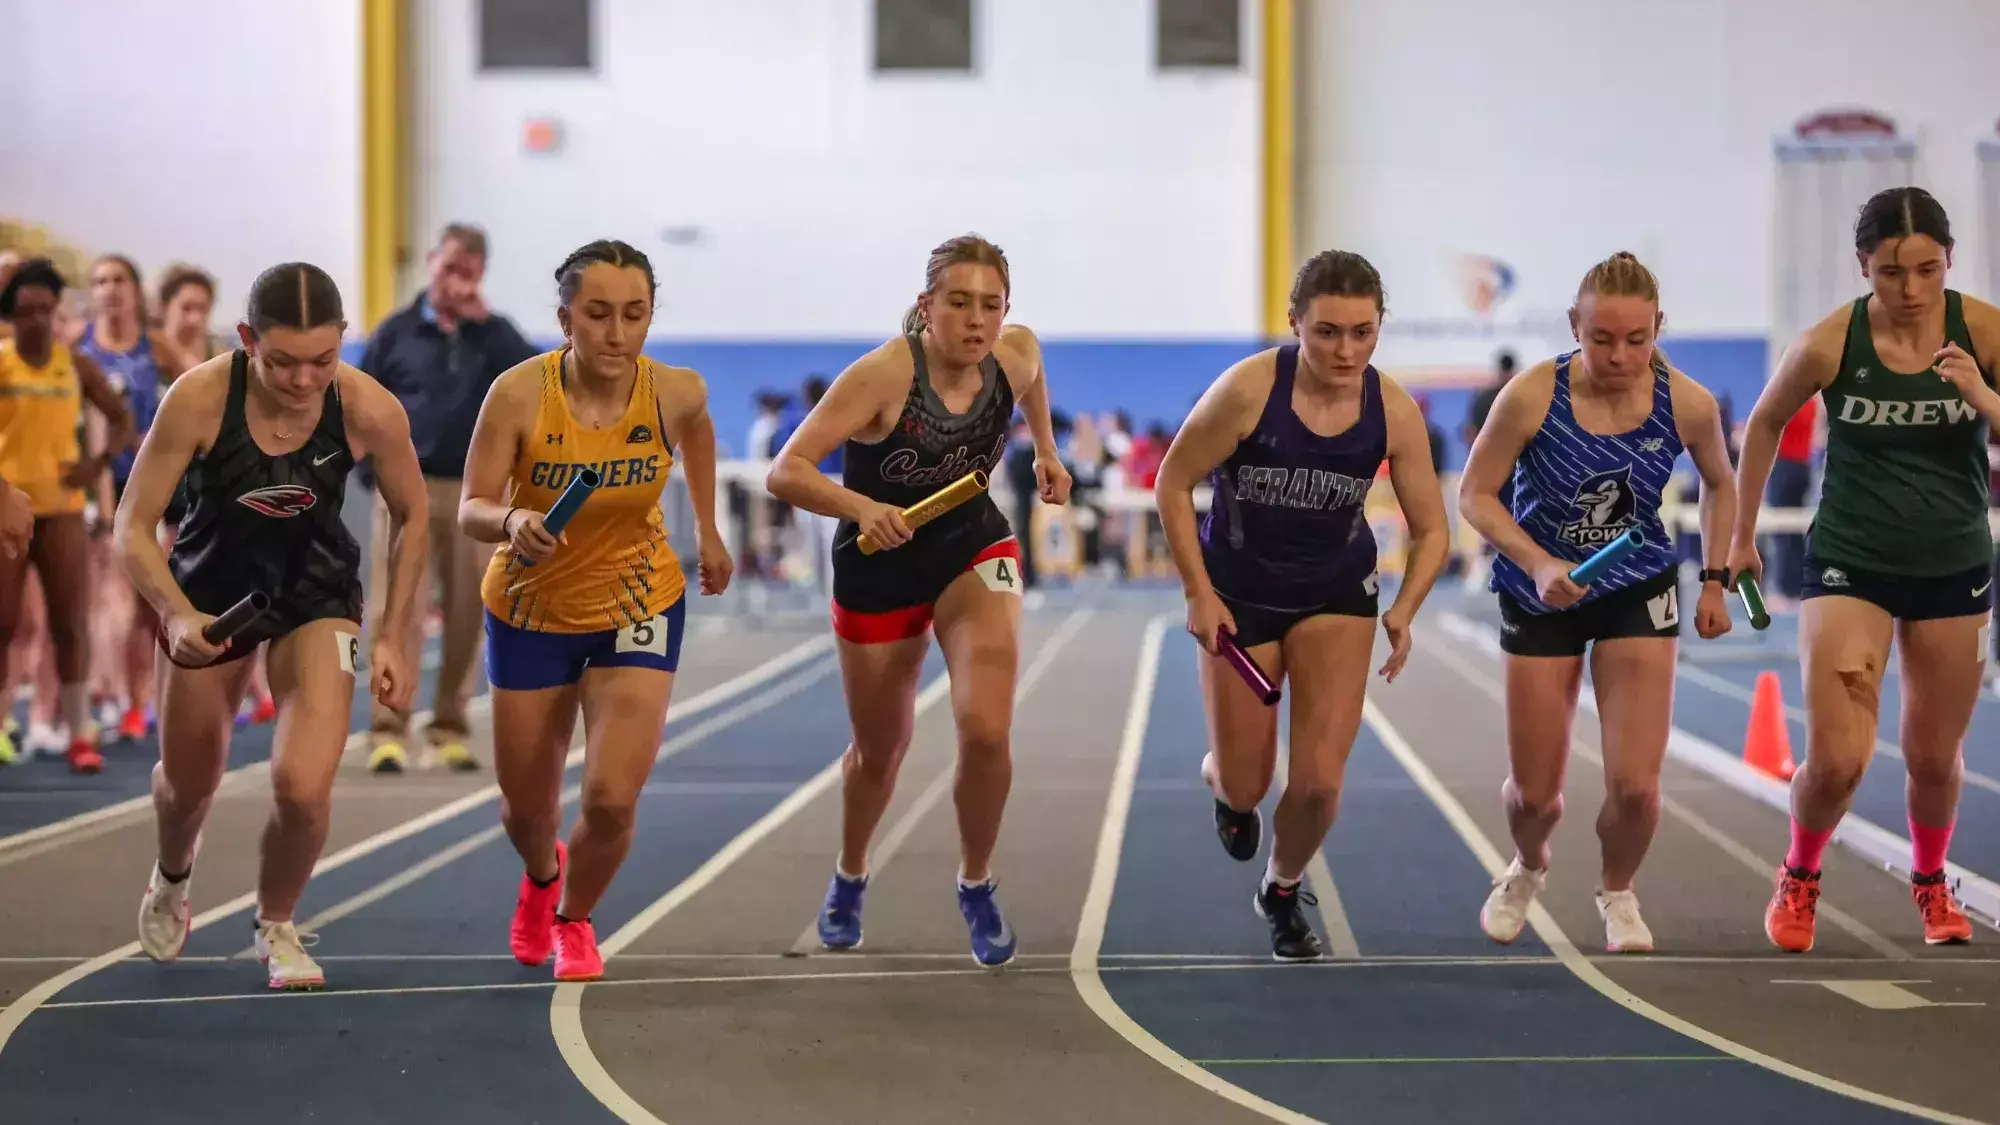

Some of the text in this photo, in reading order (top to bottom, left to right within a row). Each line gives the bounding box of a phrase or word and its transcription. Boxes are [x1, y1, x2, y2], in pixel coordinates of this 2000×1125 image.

[1236, 465, 1373, 510] SCRANTO
[996, 558, 1014, 588] 4
[1659, 590, 1674, 621] 2
[632, 616, 655, 646] 5
